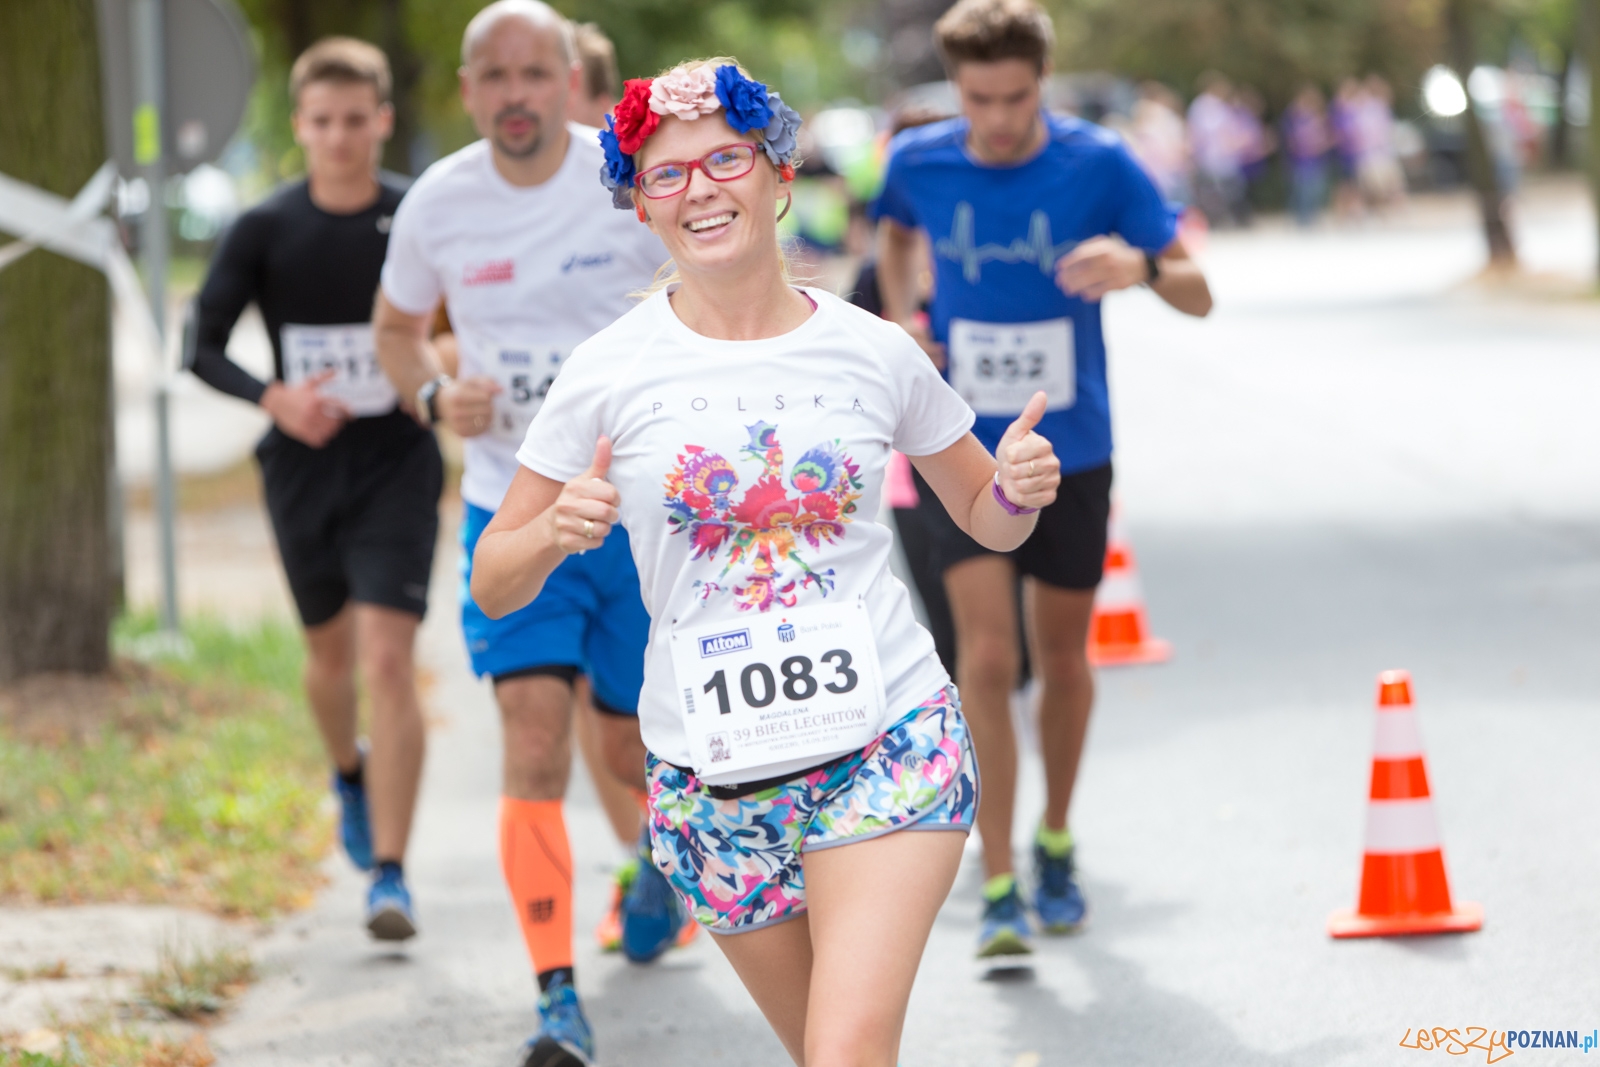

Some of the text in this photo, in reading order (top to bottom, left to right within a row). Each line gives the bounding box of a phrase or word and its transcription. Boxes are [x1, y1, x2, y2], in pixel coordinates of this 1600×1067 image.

[652, 394, 865, 416] POLSKA
[703, 649, 858, 714] 1083
[733, 728, 751, 742] 39
[755, 720, 790, 738] BIEG
[794, 705, 868, 730] LECHITÓW
[759, 707, 809, 721] MAGDALENA
